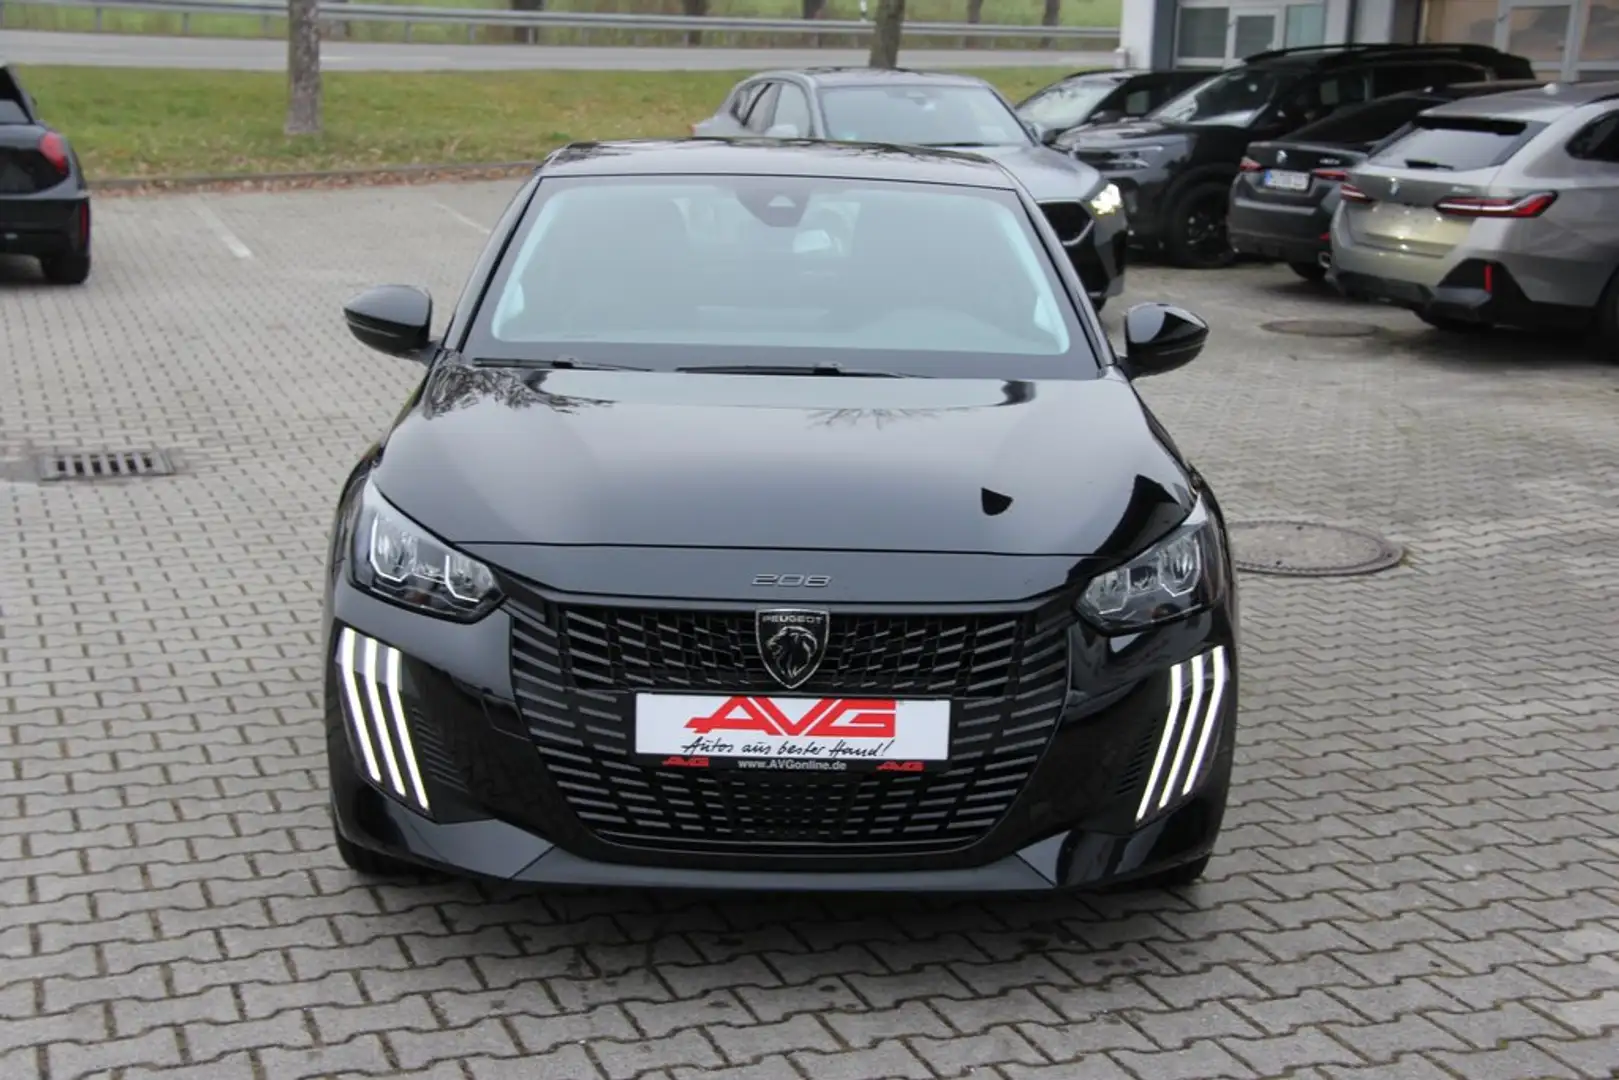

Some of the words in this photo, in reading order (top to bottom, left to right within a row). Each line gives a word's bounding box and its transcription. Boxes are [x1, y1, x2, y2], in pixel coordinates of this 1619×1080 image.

[752, 573, 831, 588] 208
[761, 614, 824, 624] PEUGEOT
[684, 696, 896, 738] AVG
[777, 740, 826, 755] bester
[828, 739, 895, 759] Hand!
[661, 756, 709, 767] AVG
[737, 758, 847, 771] www.AVGonline.de
[876, 761, 924, 772] AVG
